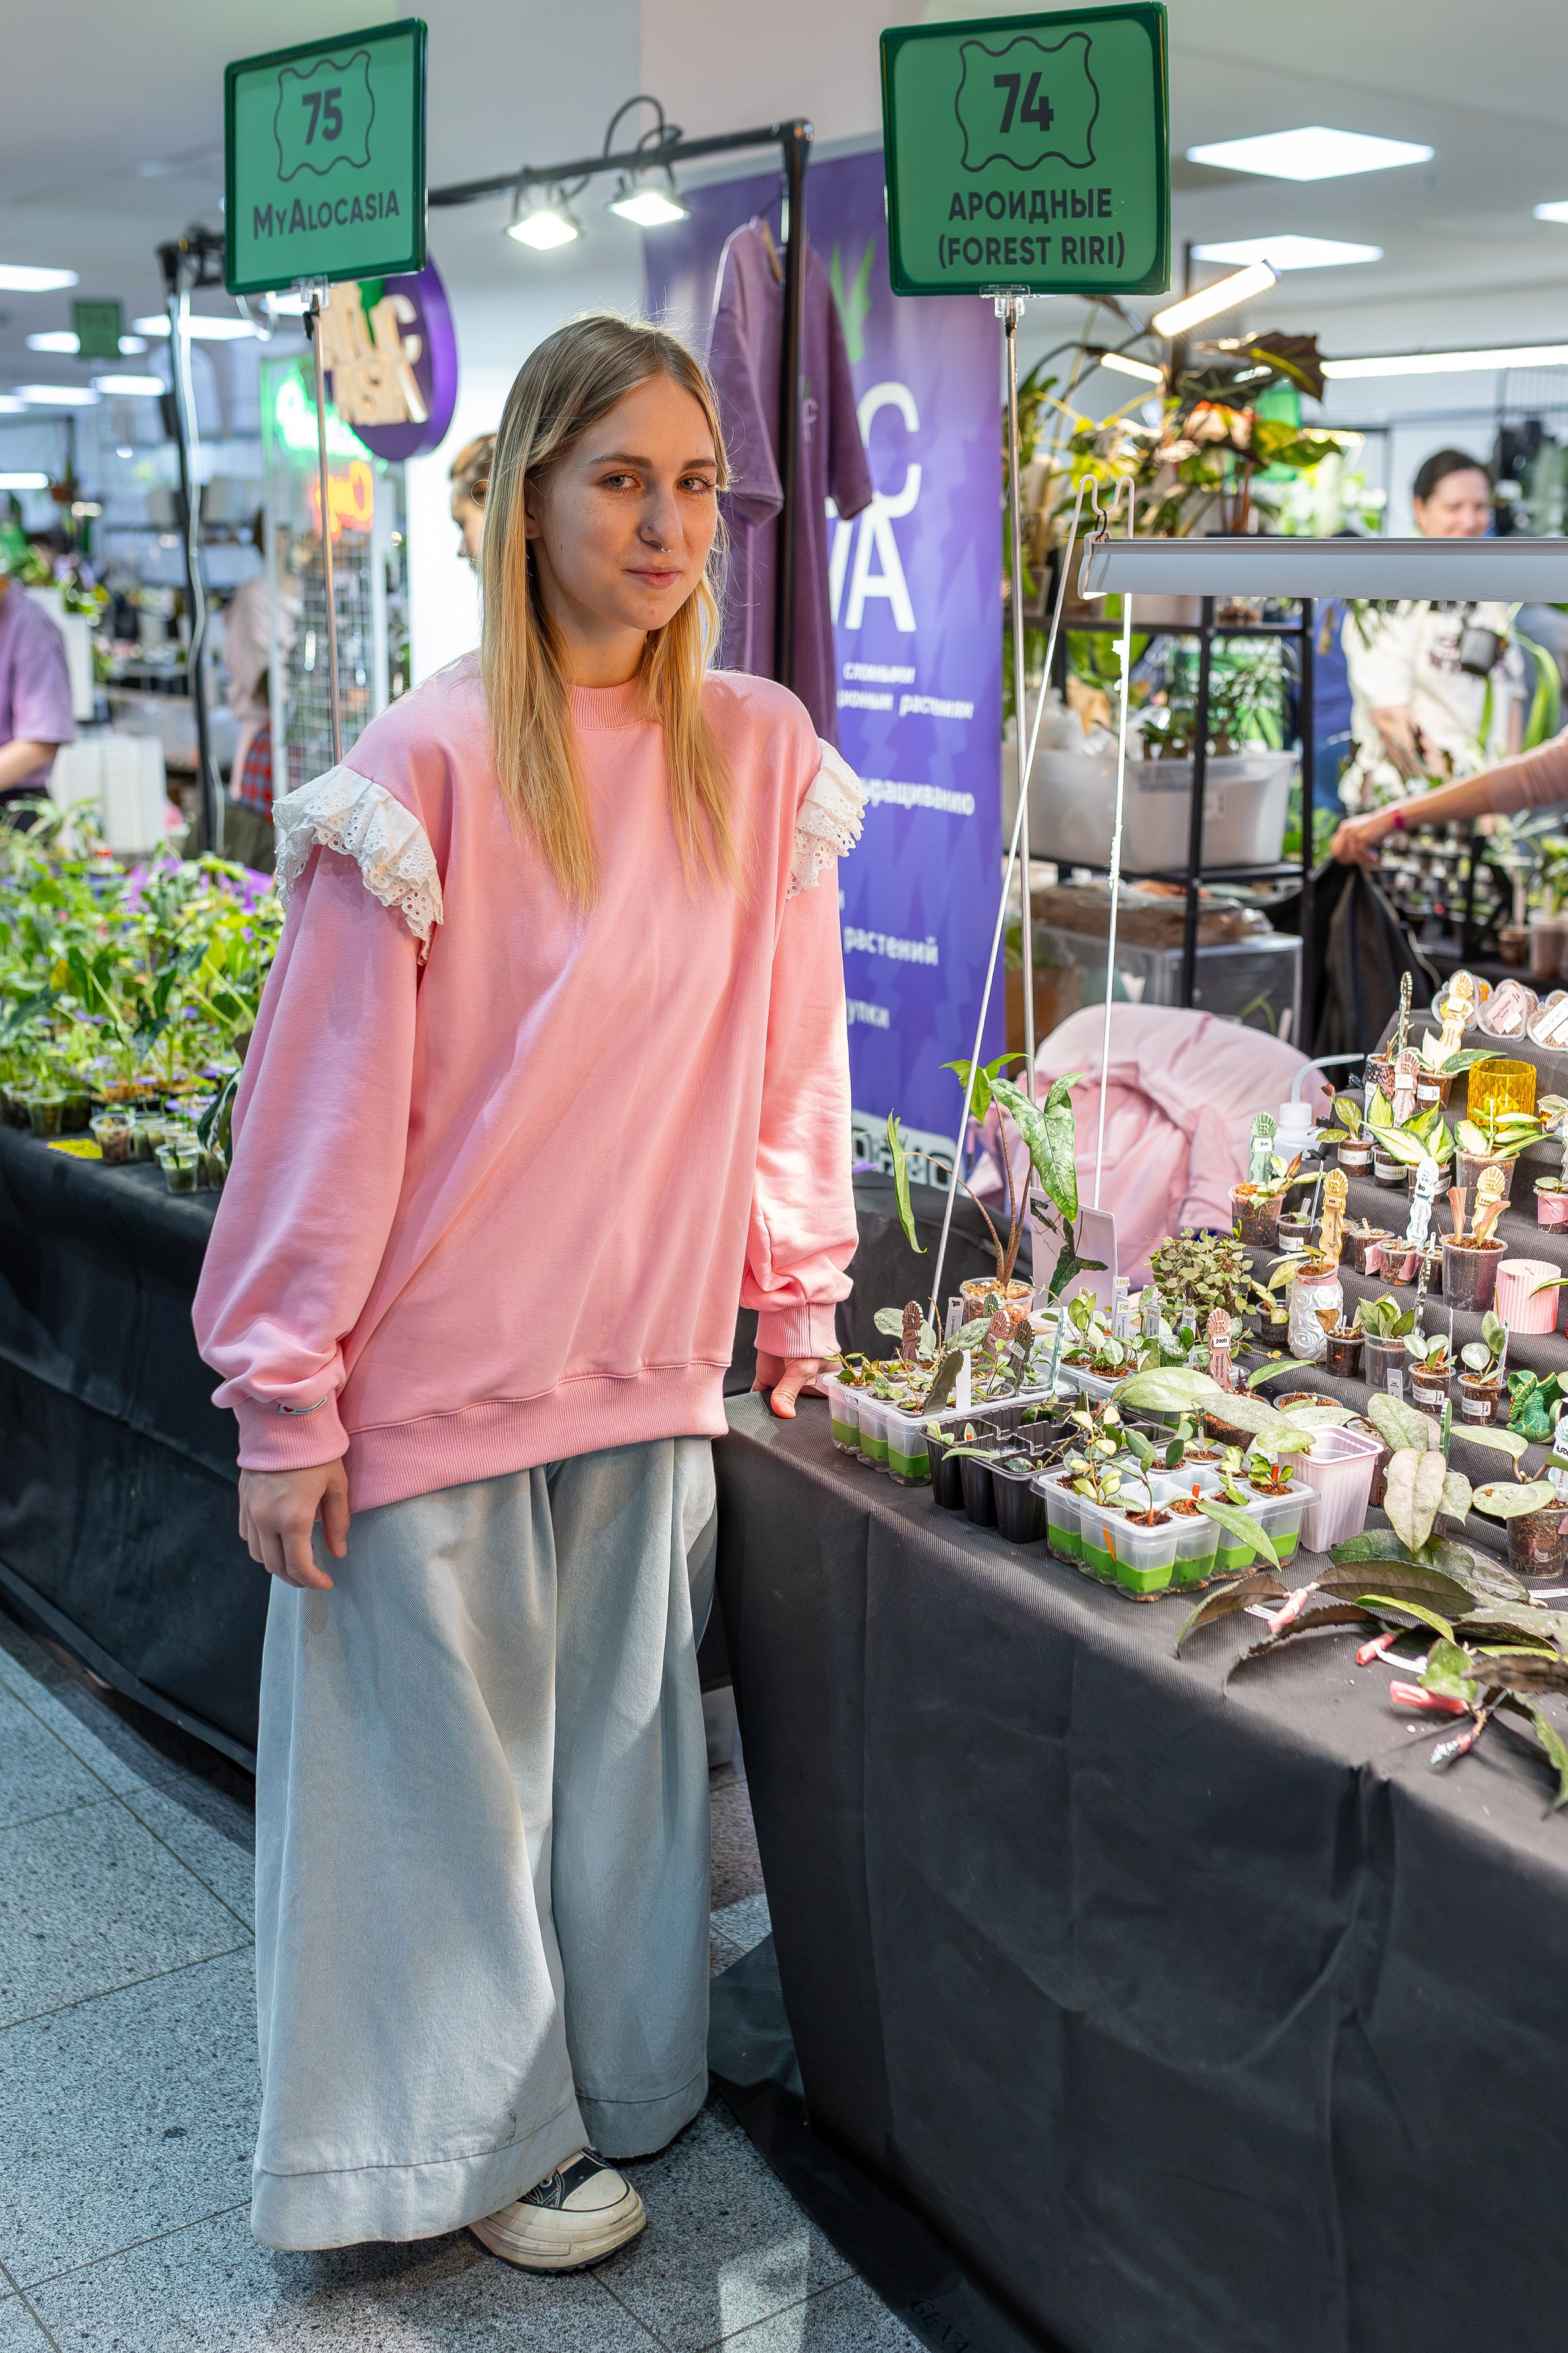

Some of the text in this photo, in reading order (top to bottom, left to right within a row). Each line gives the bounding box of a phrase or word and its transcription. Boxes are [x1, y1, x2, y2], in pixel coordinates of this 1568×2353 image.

[302, 86, 343, 145] 75
[993, 71, 1054, 134] 74
[948, 187, 1112, 224] АРОИДНЫЕ
[938, 231, 1125, 269] (FOREST RIRI)
[1014, 1346, 1023, 1355] 500
